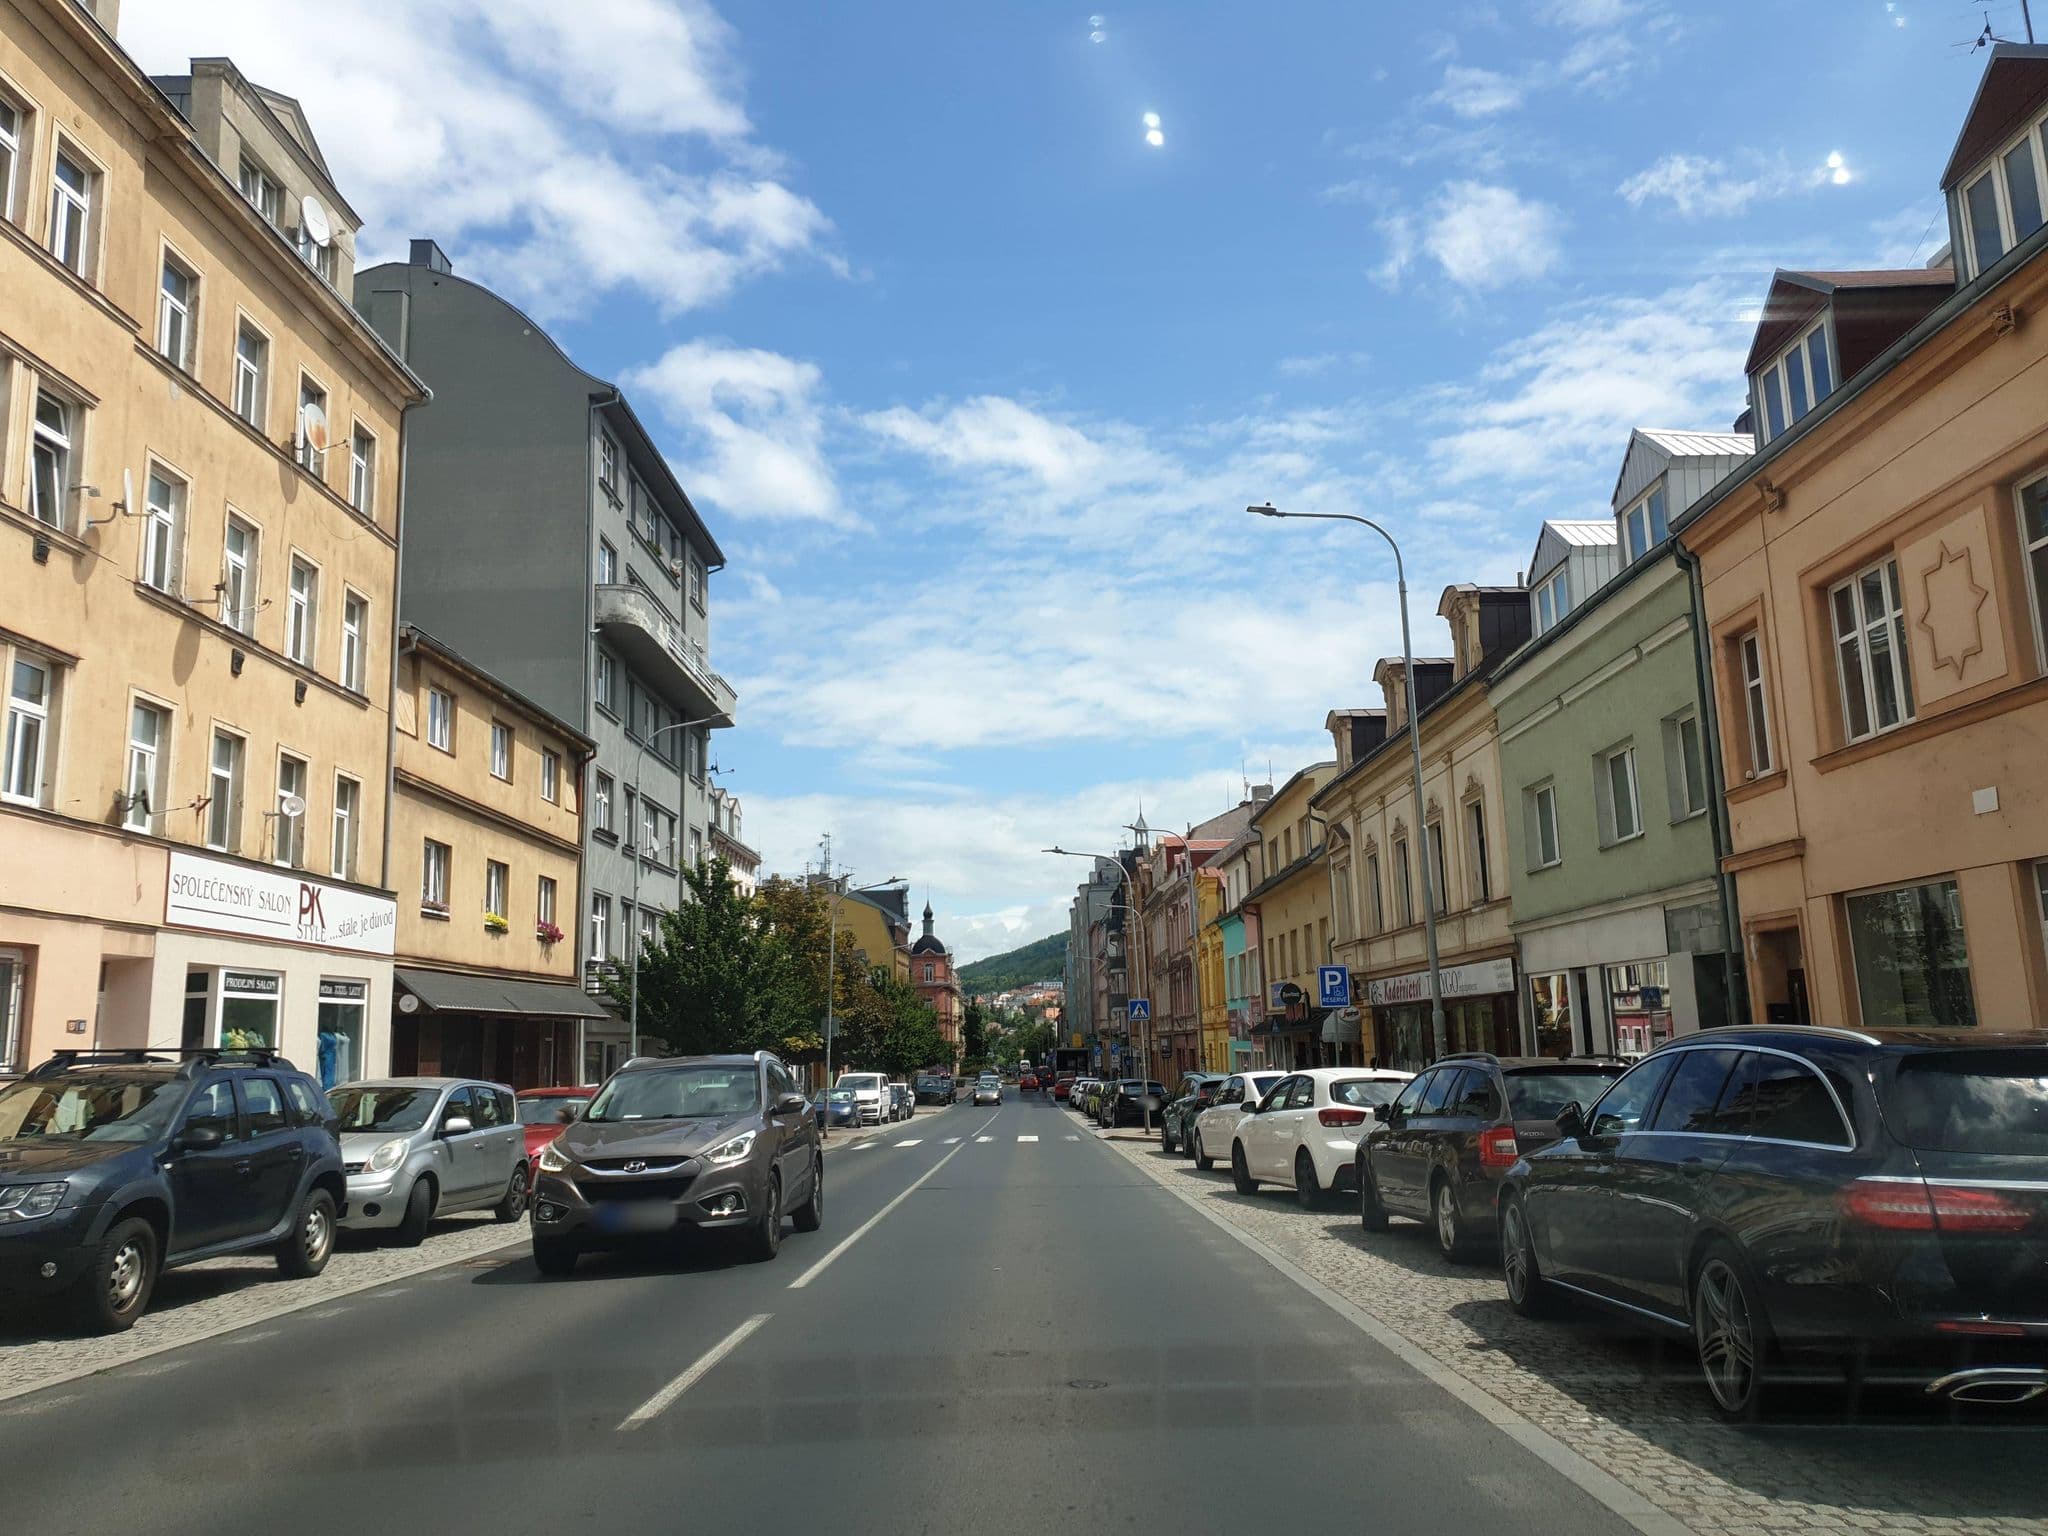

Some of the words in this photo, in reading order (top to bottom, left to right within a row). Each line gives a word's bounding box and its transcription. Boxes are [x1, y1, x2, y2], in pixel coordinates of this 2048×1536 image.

[172, 873, 254, 907] SPOLEČENSKÝ
[258, 890, 292, 914] SALON
[299, 883, 326, 928] PK
[296, 924, 327, 943] STYLE
[359, 914, 368, 937] je
[256, 979, 276, 990] SALON
[1325, 971, 1342, 994] P
[1424, 971, 1459, 996] TNGO
